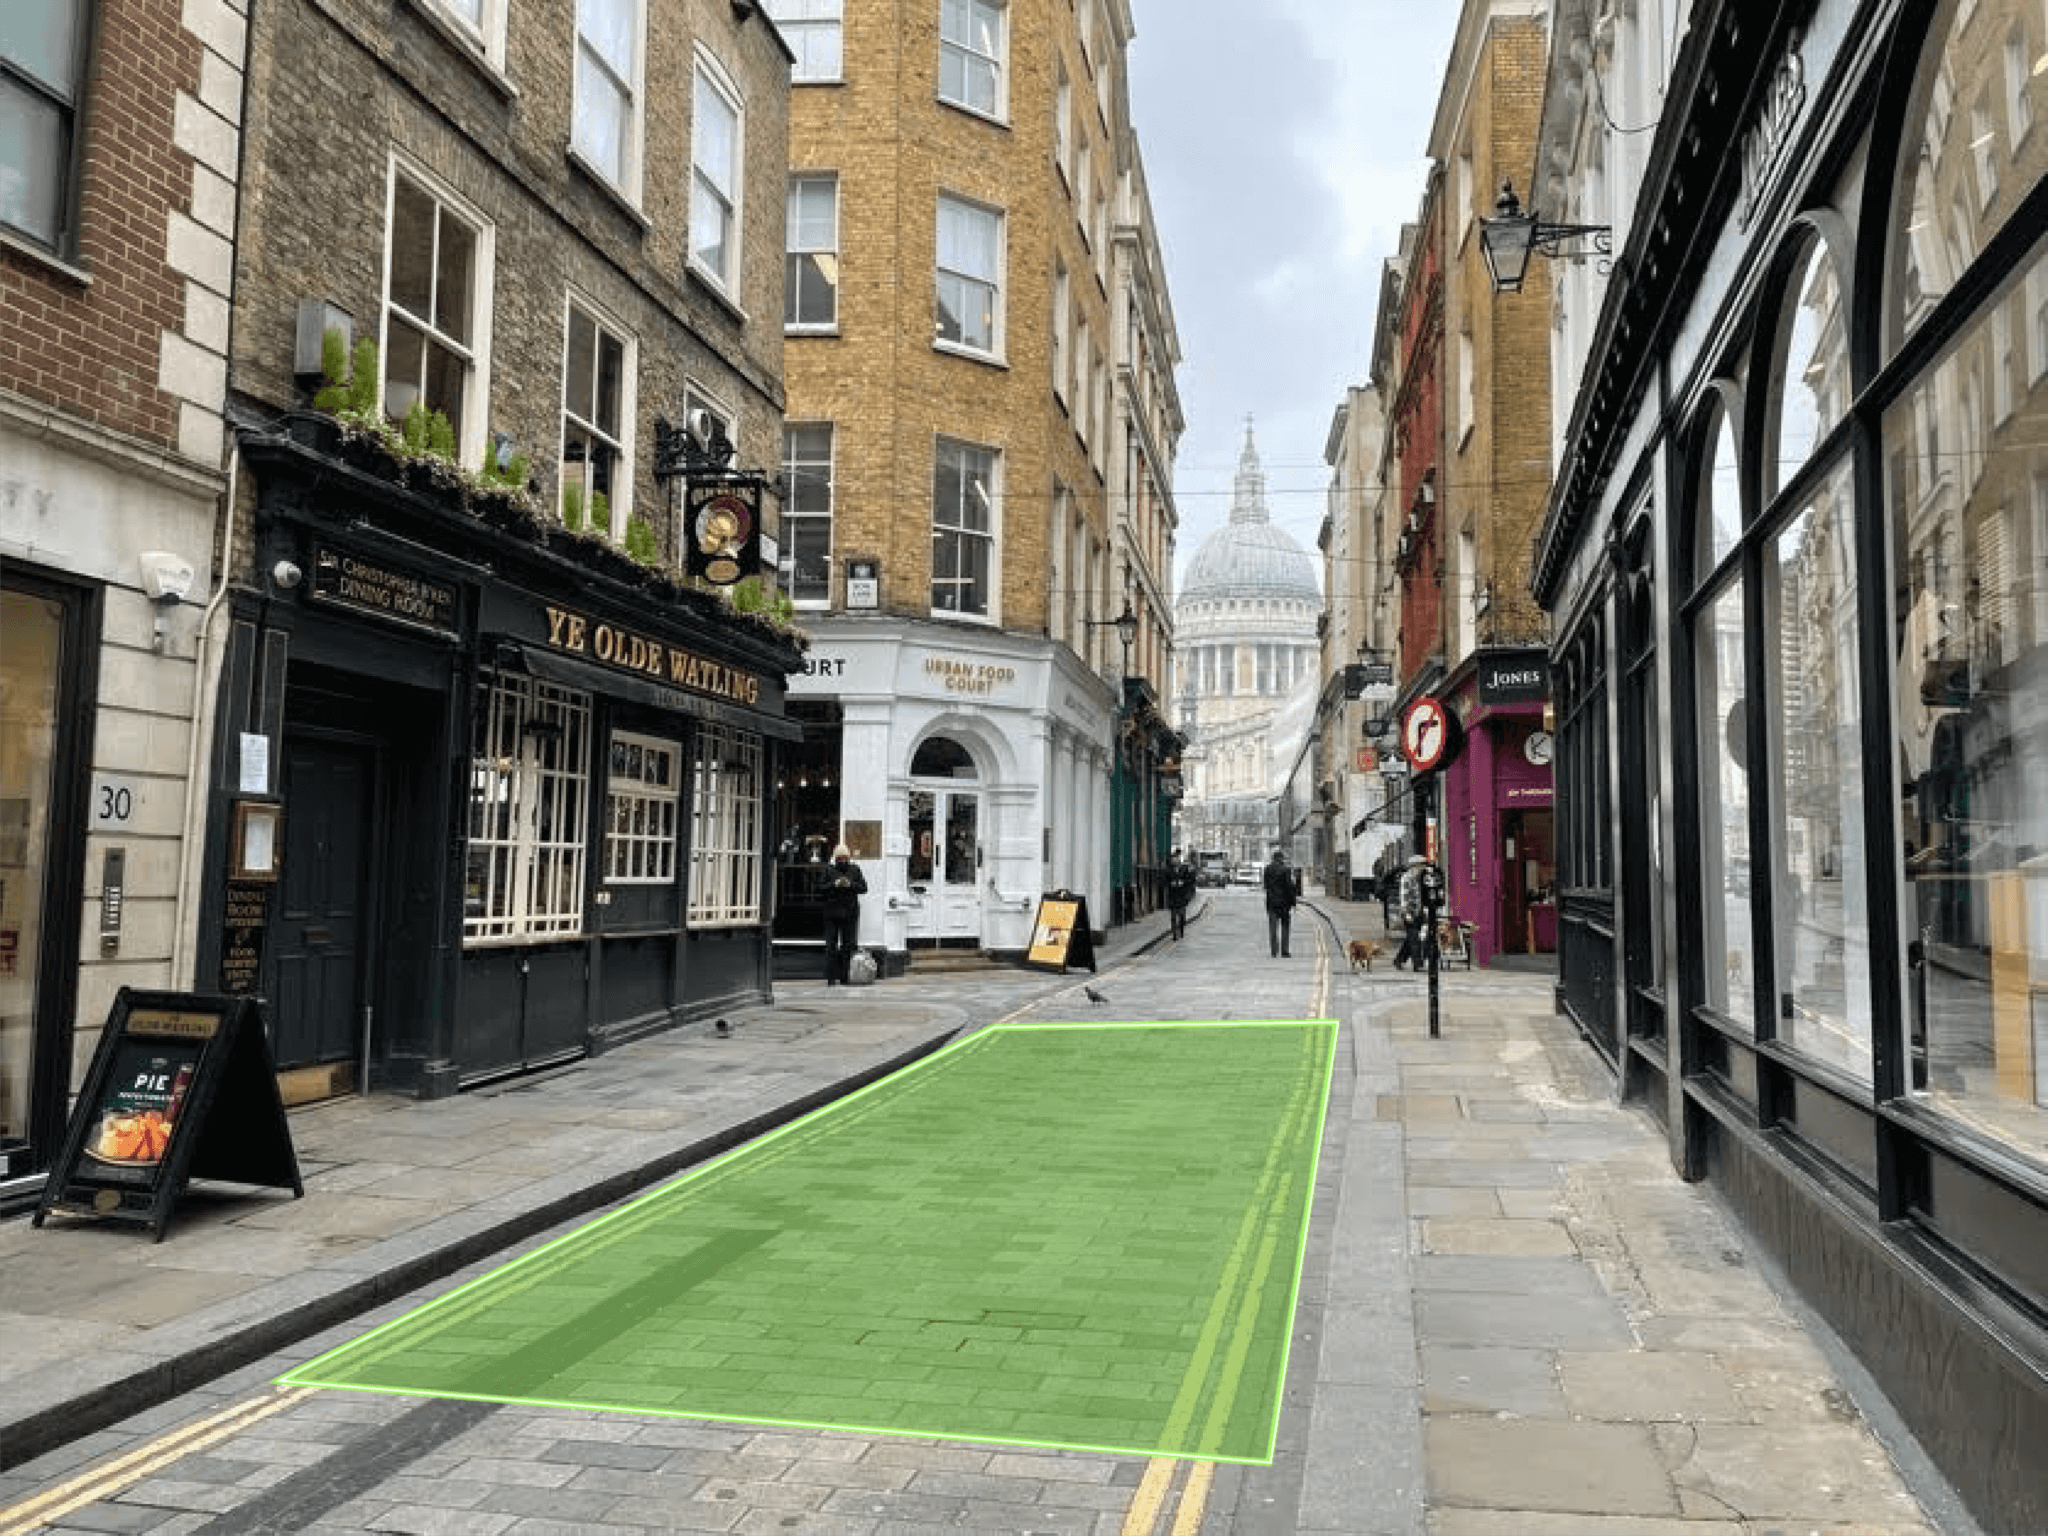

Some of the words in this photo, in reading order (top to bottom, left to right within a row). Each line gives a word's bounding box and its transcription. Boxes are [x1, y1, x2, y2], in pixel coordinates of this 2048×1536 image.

[394, 593, 435, 620] ROOM
[546, 606, 587, 650] YE
[594, 624, 663, 675] OLDE
[669, 649, 759, 704] WATLING
[925, 658, 974, 678] URBAN
[979, 665, 1016, 683] FOOD
[1486, 670, 1540, 690] JONES
[945, 677, 994, 697] COURT
[100, 785, 131, 820] 30
[134, 1073, 170, 1091] PIE
